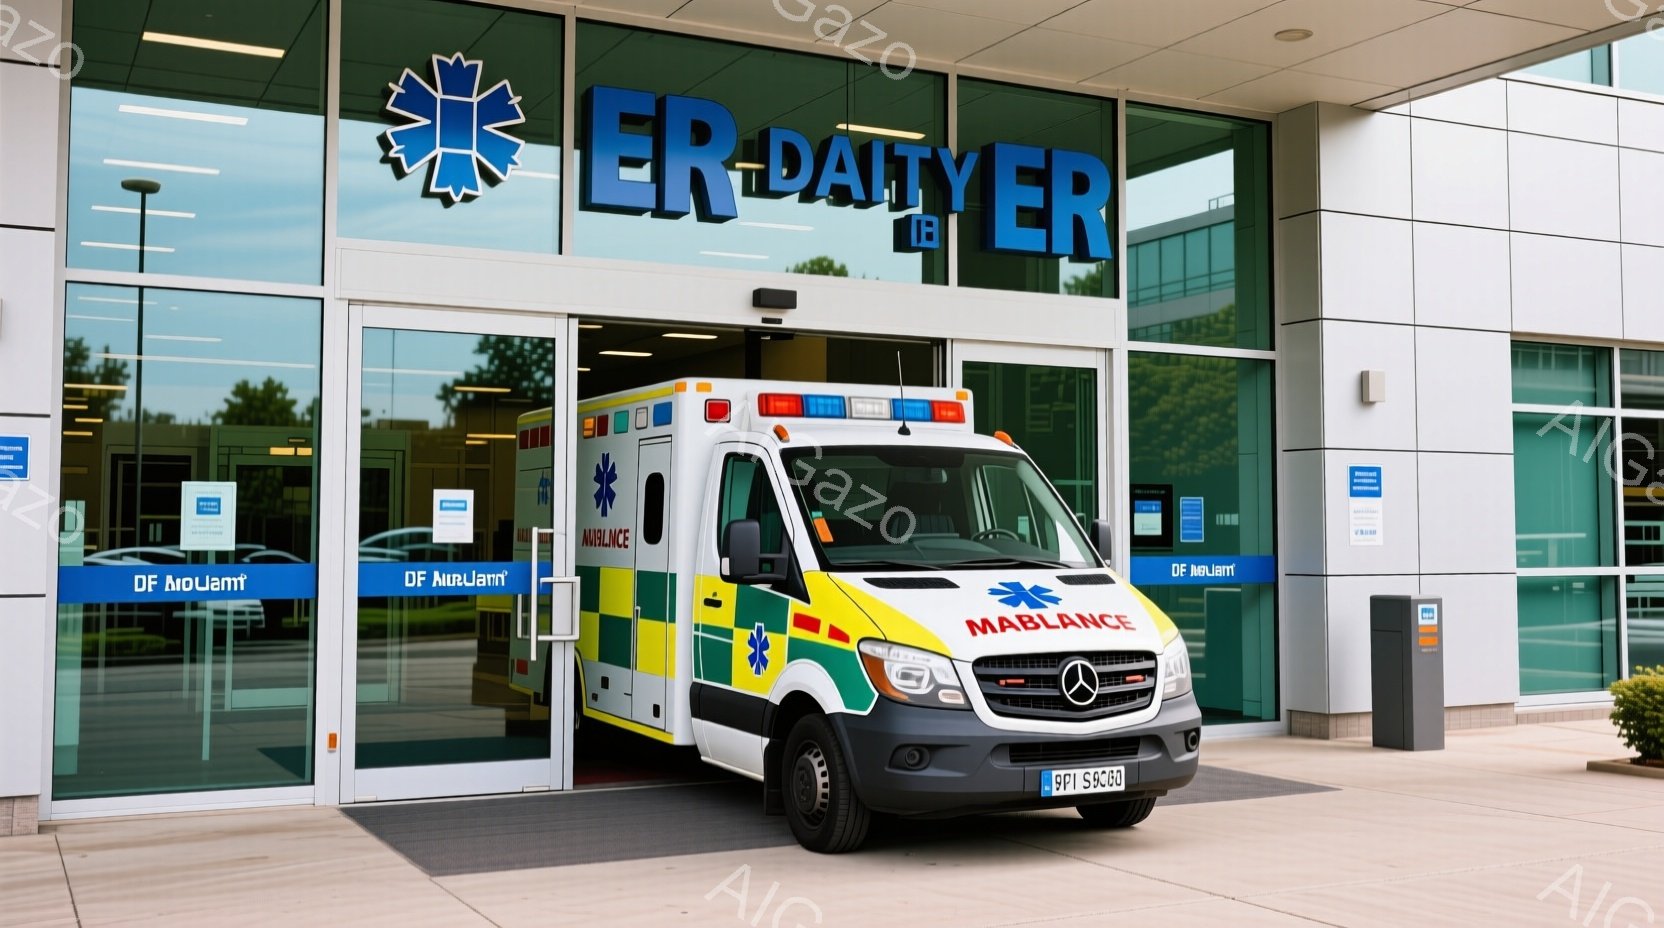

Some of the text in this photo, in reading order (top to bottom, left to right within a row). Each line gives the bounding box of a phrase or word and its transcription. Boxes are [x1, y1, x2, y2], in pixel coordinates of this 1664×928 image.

[584, 85, 1113, 260] ER DAITY ER
[965, 612, 1137, 637] MABLANCE
